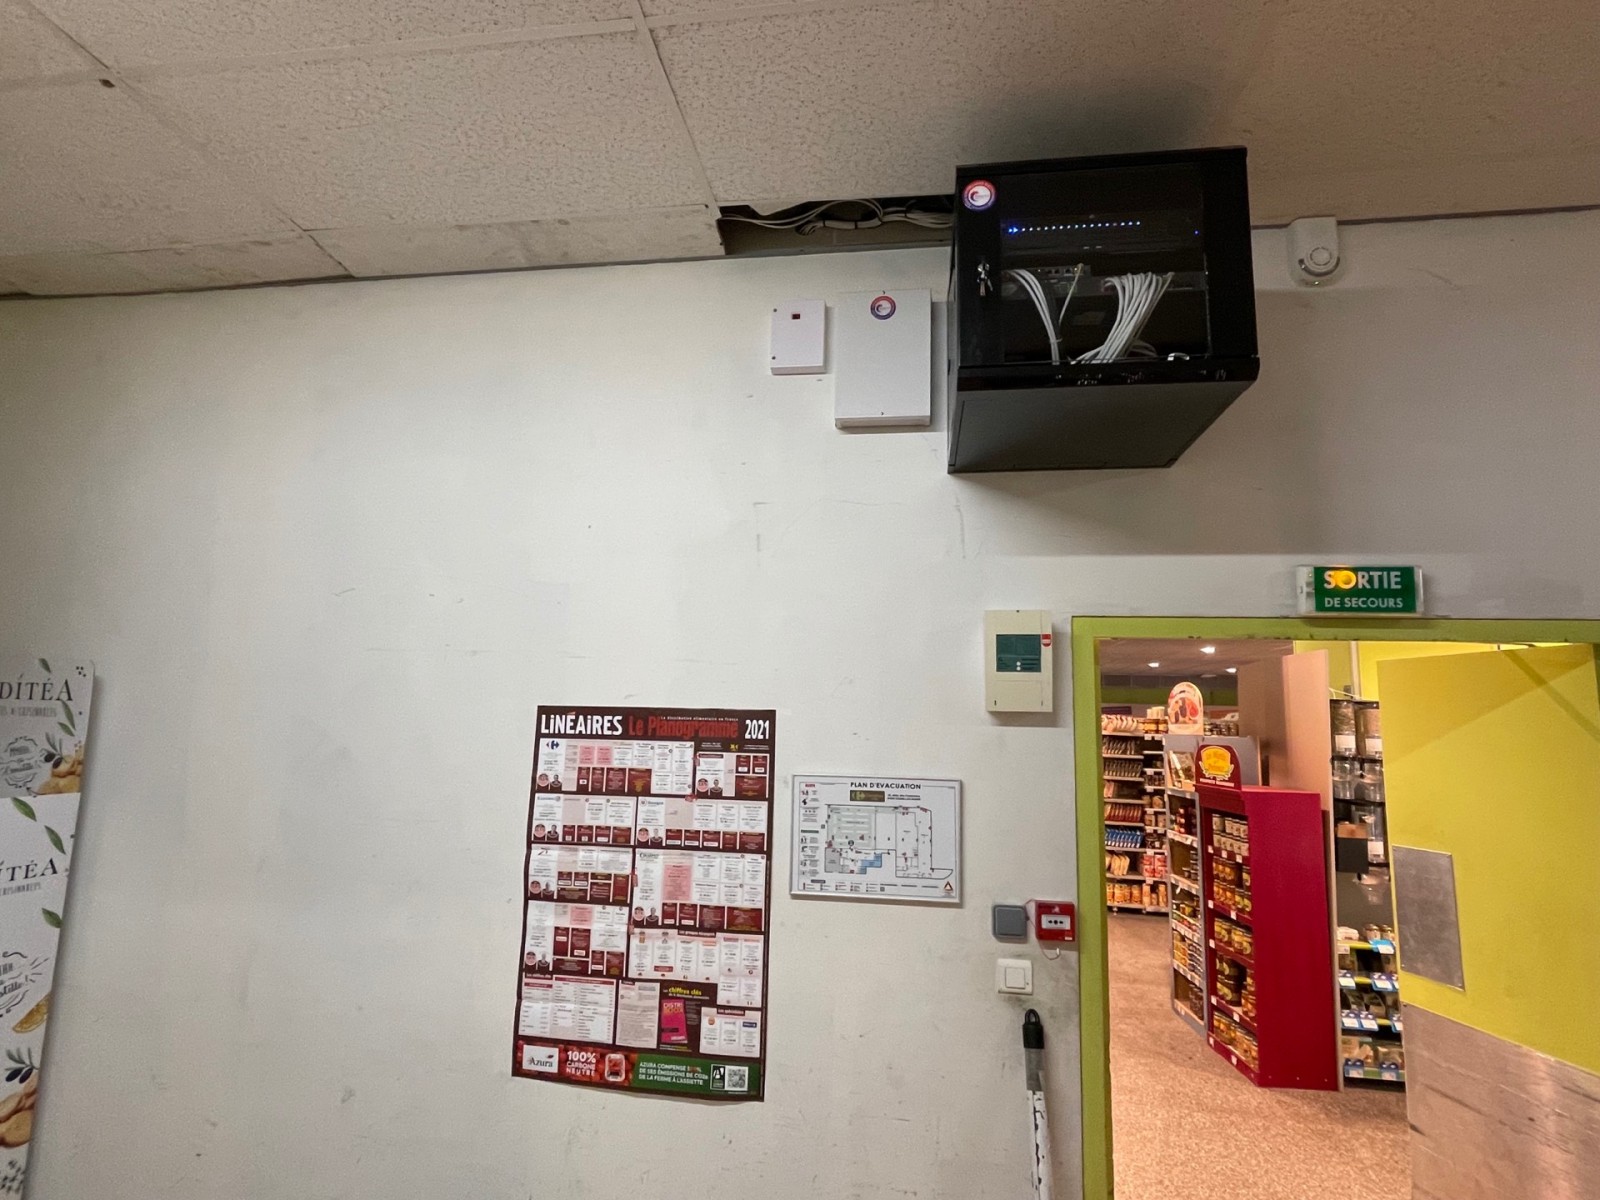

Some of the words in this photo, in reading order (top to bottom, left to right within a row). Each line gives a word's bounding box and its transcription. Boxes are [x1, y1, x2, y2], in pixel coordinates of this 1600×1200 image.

[1323, 569, 1402, 589] SORTIE
[1324, 597, 1341, 608] DE
[1344, 597, 1403, 608] SECOURS
[627, 715, 644, 736] Le
[648, 716, 739, 739] Planogramme
[744, 719, 770, 740] 2021
[528, 1057, 553, 1068] Azura
[567, 1051, 596, 1063] 100%
[566, 1061, 596, 1070] CARBONE
